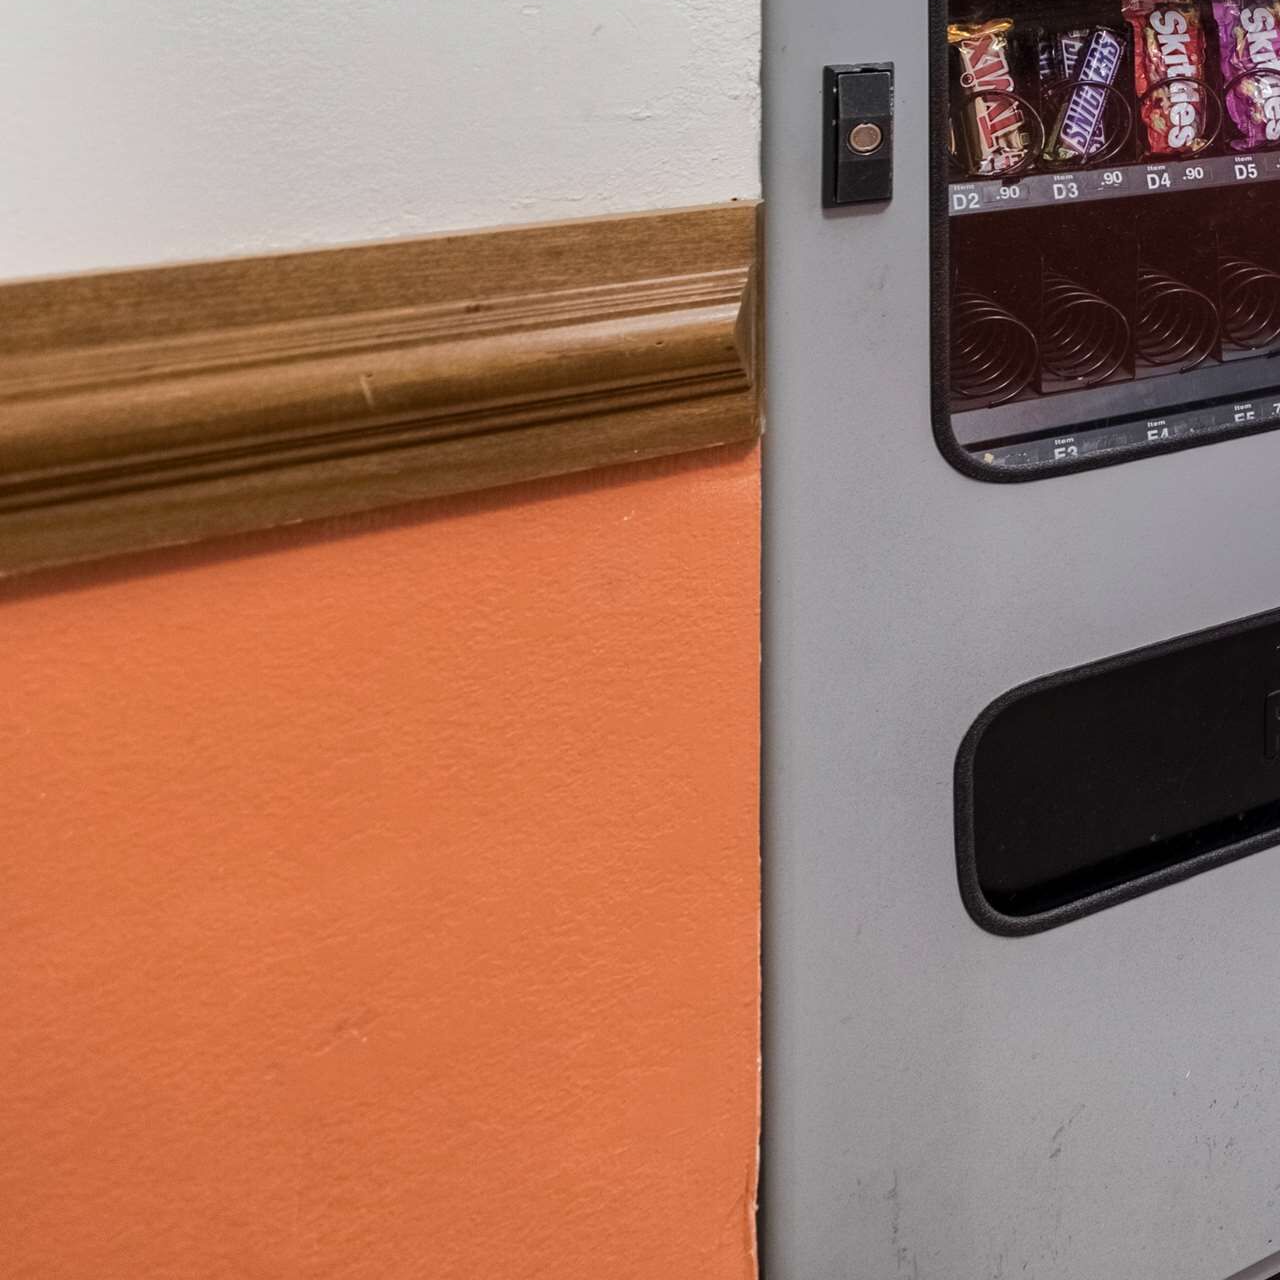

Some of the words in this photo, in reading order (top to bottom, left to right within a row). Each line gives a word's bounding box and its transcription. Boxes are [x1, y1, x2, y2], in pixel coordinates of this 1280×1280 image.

[1150, 10, 1201, 149] Skittles
[1101, 171, 1122, 186] .90
[1183, 167, 1204, 180] .90
[1234, 163, 1258, 180] D5
[1147, 173, 1171, 190] D4
[996, 186, 1020, 200] .90
[1053, 183, 1078, 200] D3
[953, 193, 980, 210] D2
[1234, 403, 1252, 412] Item
[1147, 419, 1166, 428] Item
[1055, 437, 1074, 445] Item
